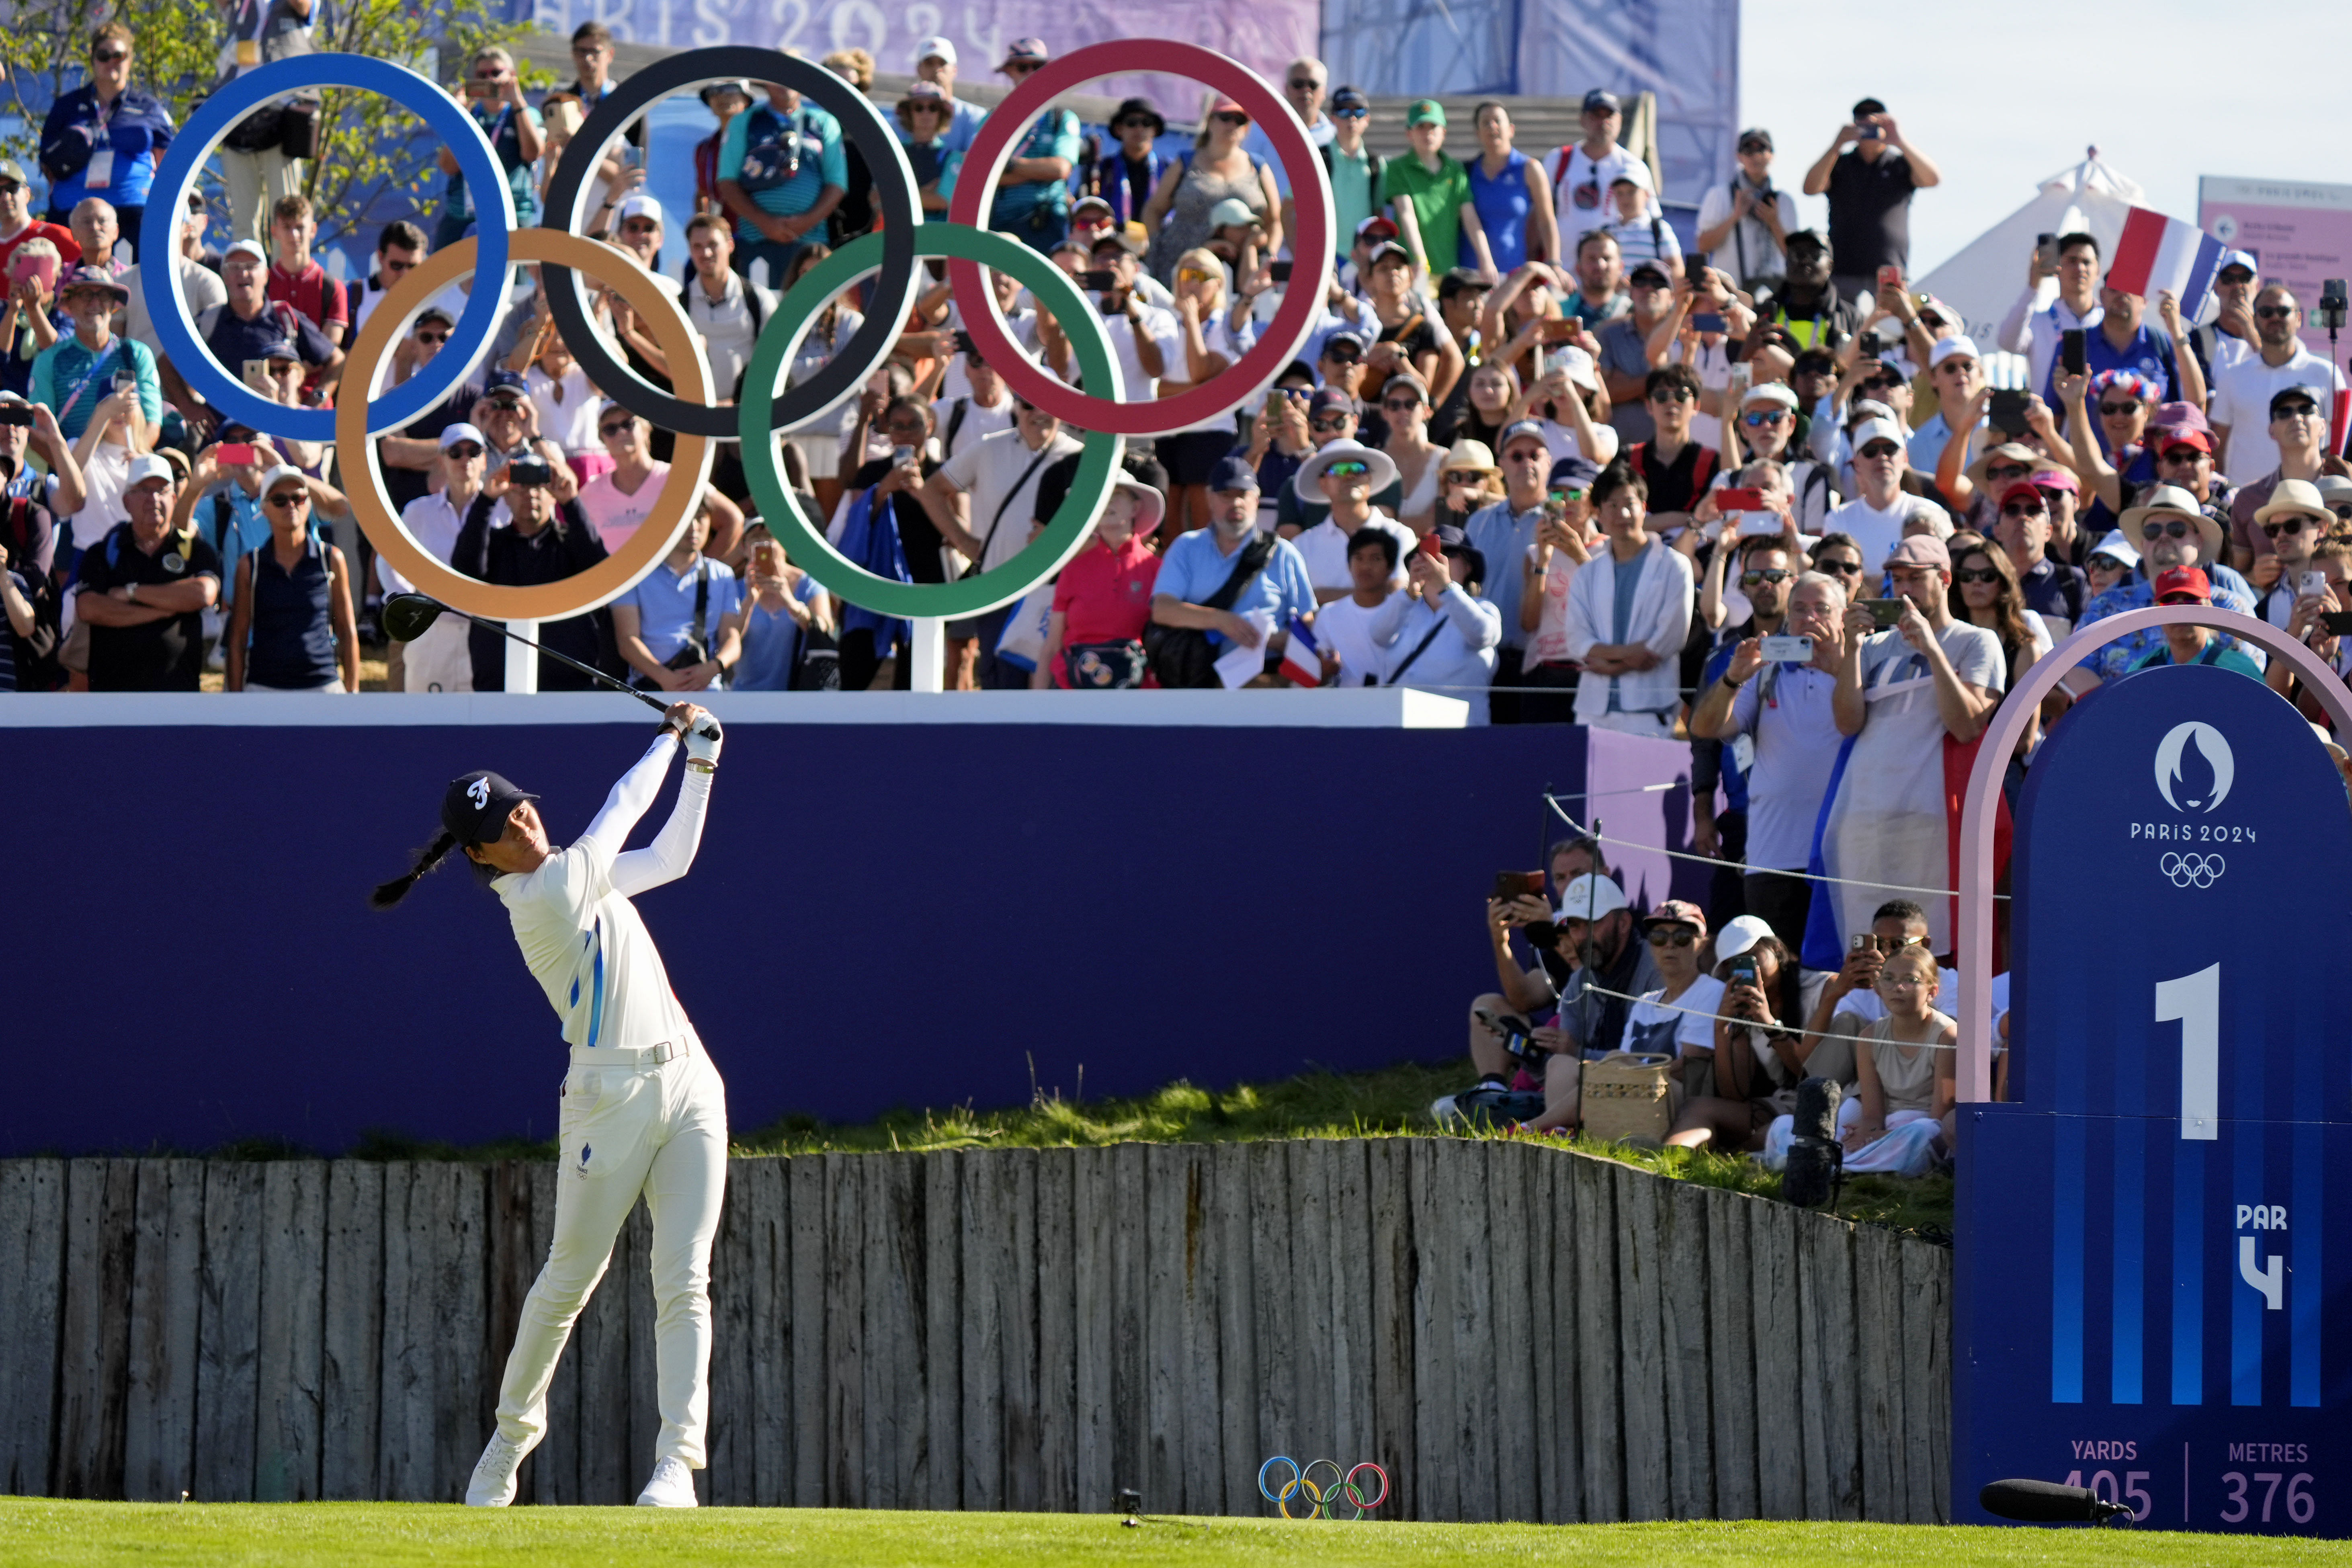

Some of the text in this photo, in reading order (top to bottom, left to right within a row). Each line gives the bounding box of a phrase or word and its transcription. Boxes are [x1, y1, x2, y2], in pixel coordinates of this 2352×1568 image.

[771, 0, 1002, 68] 2024
[2131, 823, 2256, 842] PARIS 2024
[2155, 961, 2220, 1140] 1
[2237, 1205, 2287, 1230] PAR
[2239, 1236, 2283, 1310] 4
[2071, 1440, 2137, 1460] YARDS
[2229, 1443, 2308, 1463] METRES
[2220, 1472, 2315, 1523] 376
